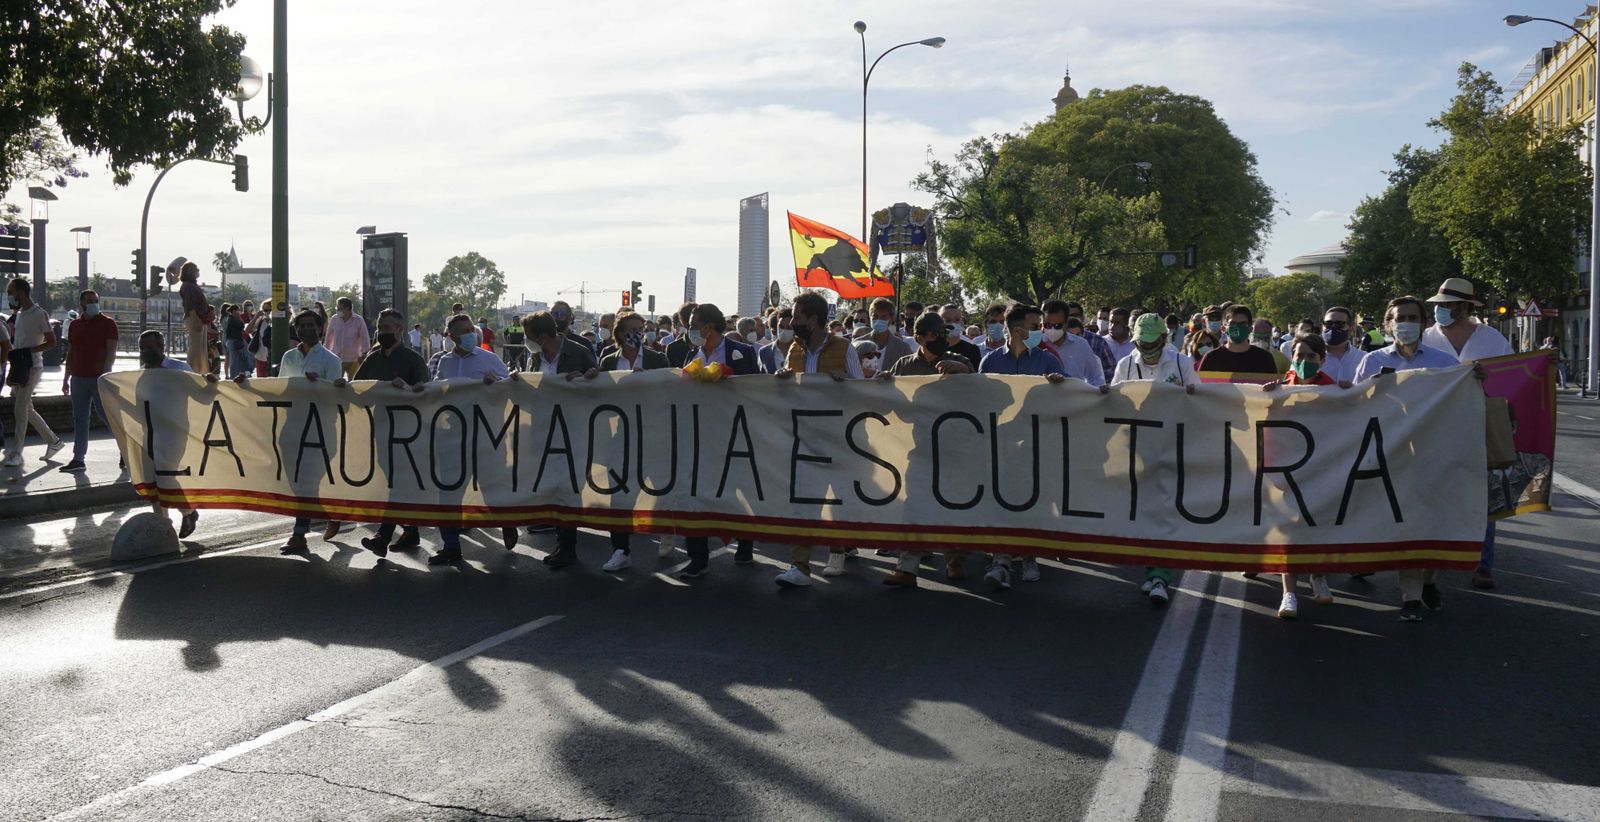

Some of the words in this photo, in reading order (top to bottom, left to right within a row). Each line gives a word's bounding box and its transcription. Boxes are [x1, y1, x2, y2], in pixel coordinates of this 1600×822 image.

[144, 400, 245, 477] LA
[256, 401, 764, 500] TAUROMAQUIA
[790, 409, 901, 506] ES
[931, 411, 1404, 527] CULTURA
